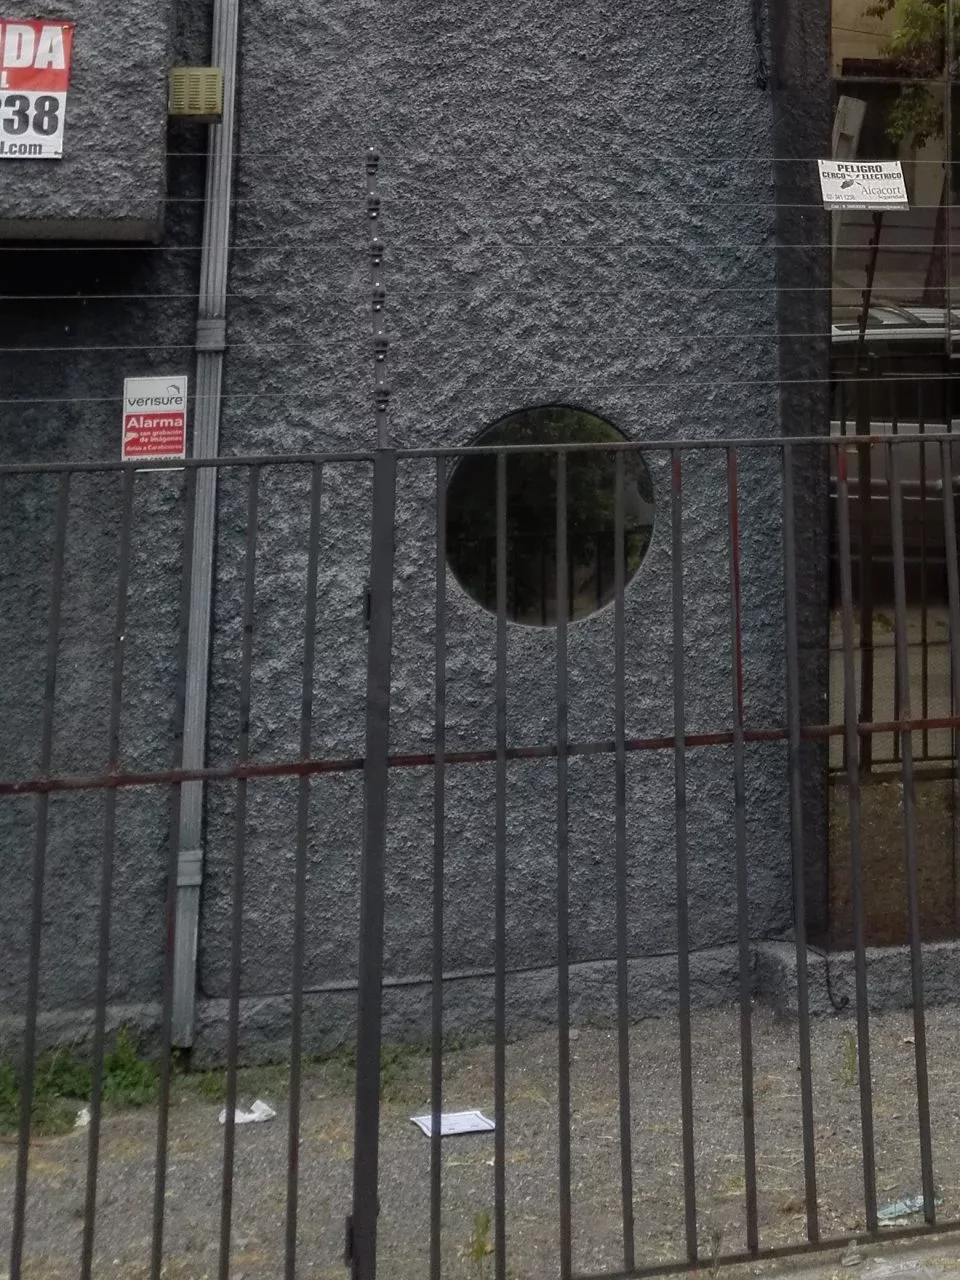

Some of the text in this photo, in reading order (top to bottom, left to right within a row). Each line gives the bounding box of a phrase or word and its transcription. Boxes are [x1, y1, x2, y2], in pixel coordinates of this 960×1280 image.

[0, 24, 65, 69] DA
[0, 95, 60, 136] 38
[837, 164, 883, 173] PELIGRO
[822, 171, 902, 180] CERCO ELECTRICO
[128, 396, 183, 407] verisure
[127, 416, 183, 429] Alarma
